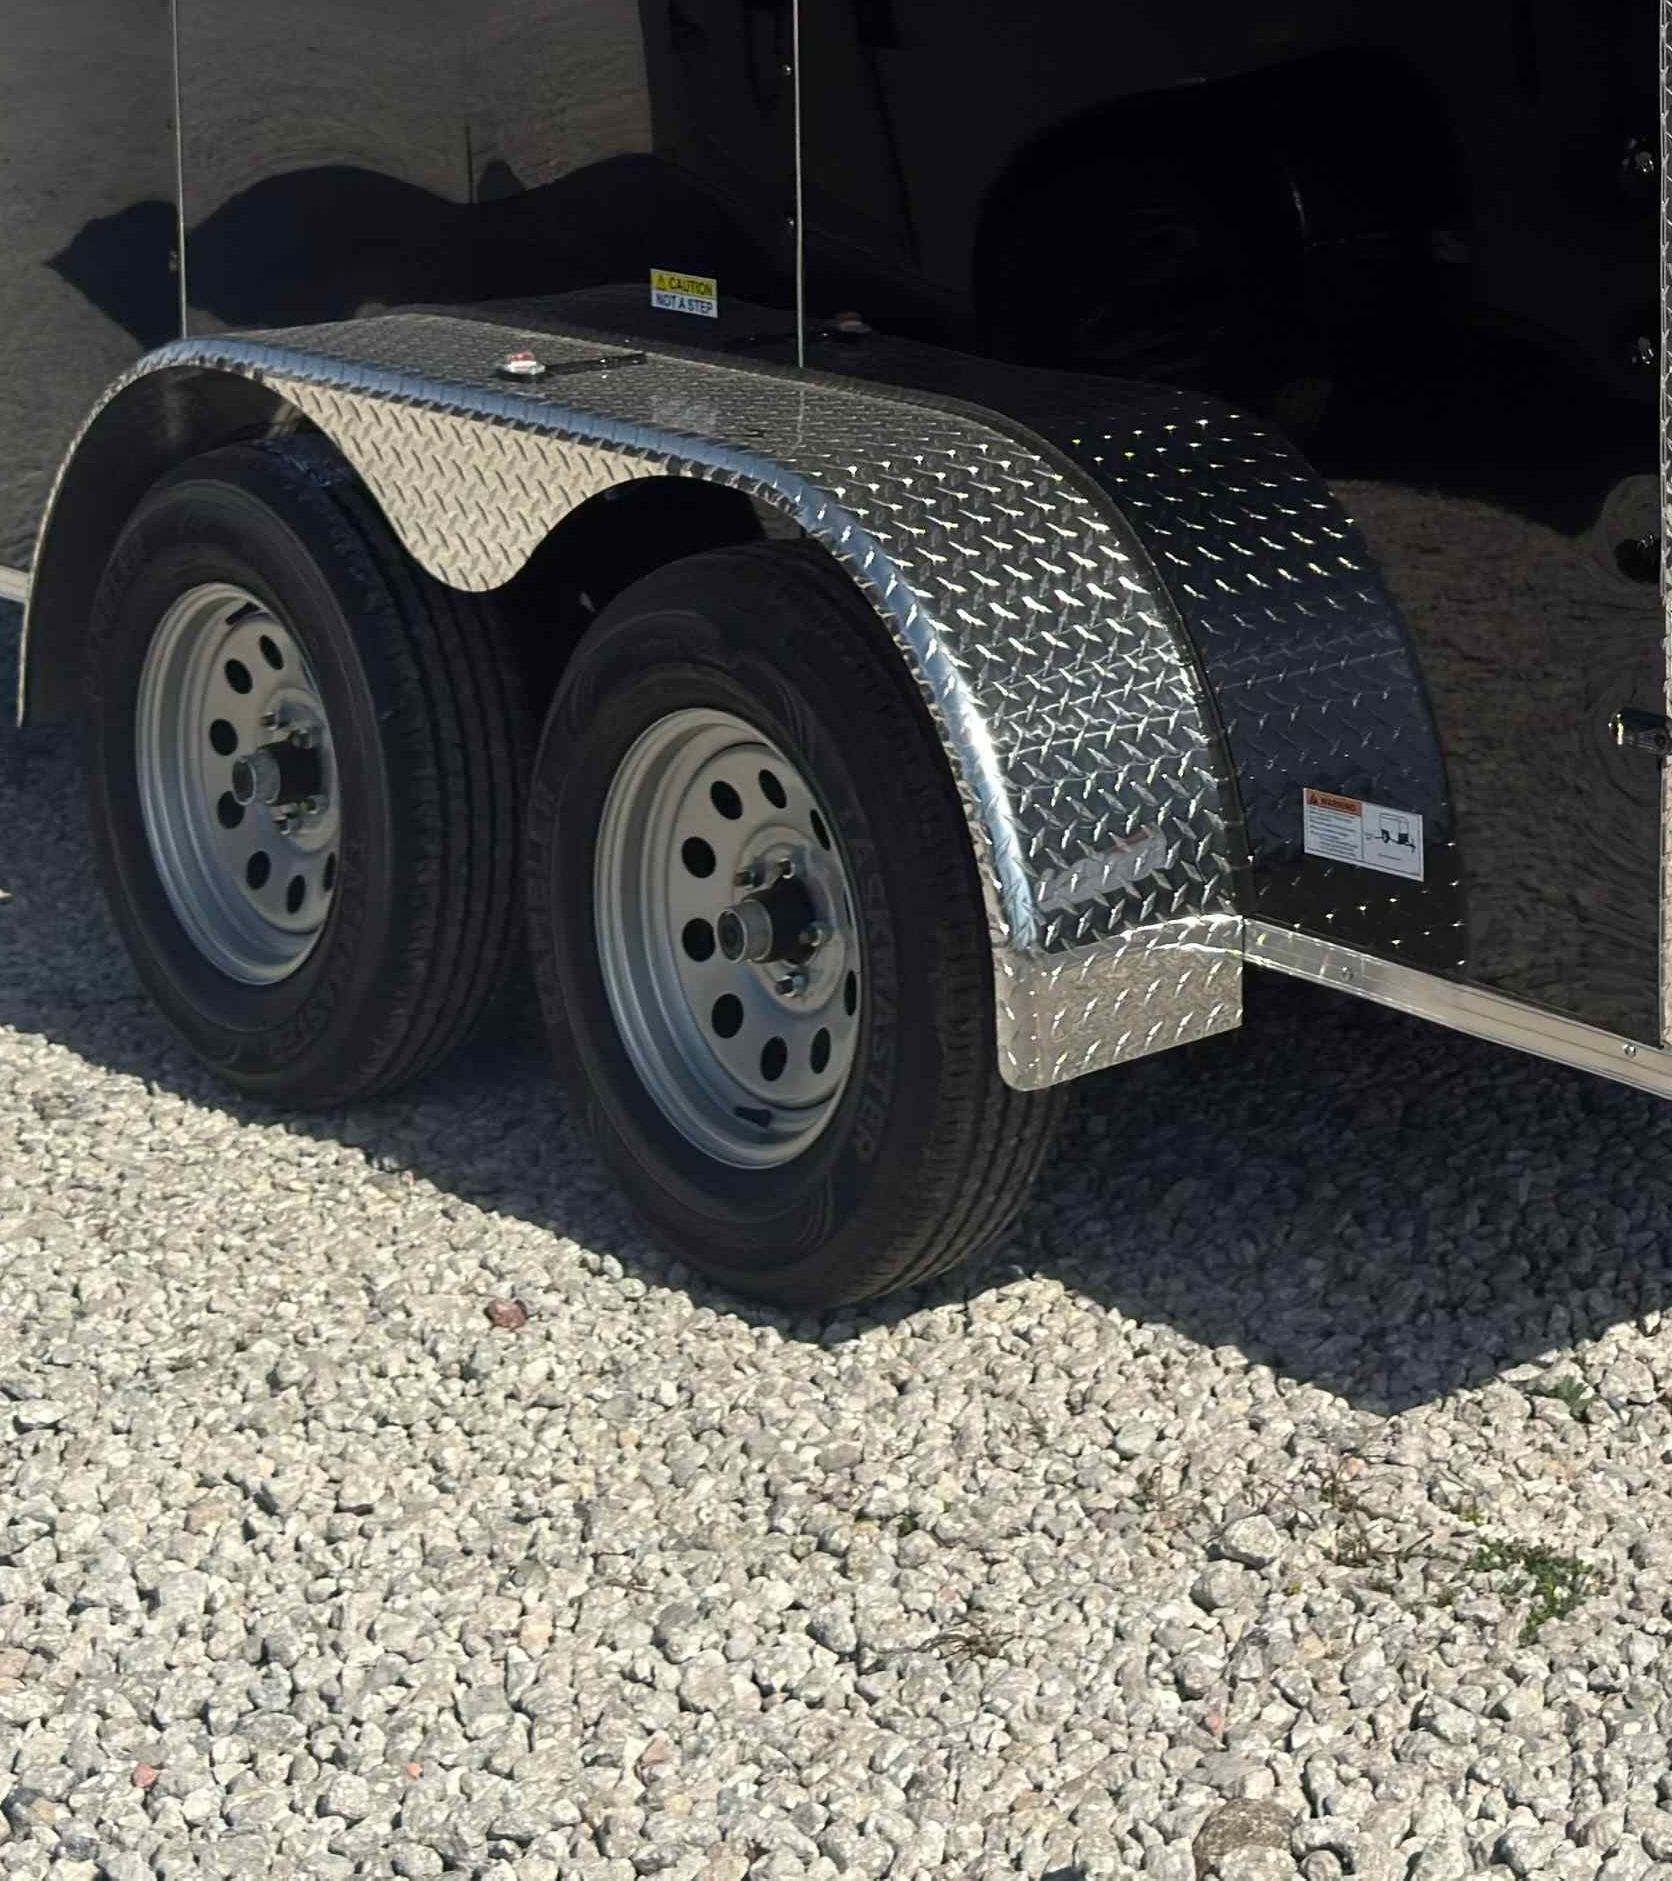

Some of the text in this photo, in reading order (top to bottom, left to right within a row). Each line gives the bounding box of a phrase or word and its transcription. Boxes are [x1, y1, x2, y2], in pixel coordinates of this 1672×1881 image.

[669, 277, 712, 296] CAUTION
[656, 292, 713, 313] NOT A STEP
